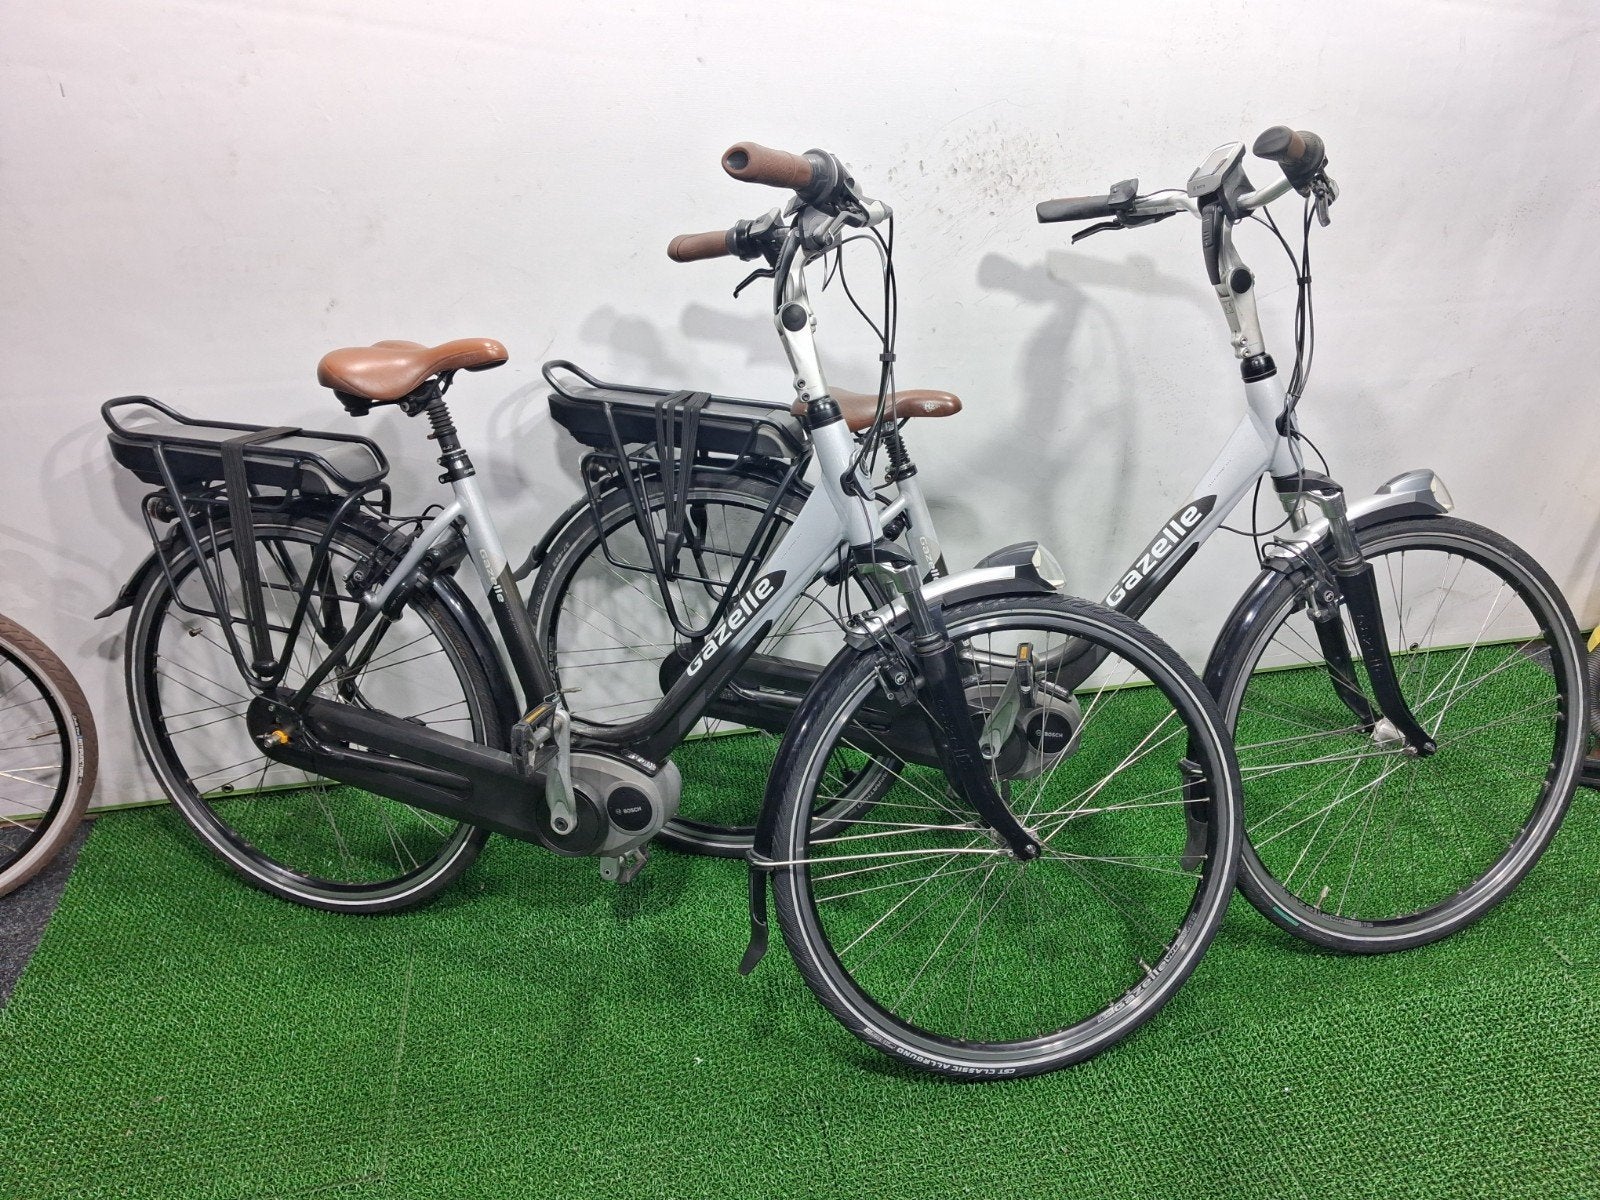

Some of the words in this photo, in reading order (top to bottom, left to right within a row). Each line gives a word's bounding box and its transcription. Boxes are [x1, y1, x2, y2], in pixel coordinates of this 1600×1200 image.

[1106, 505, 1203, 607] Gazelle
[479, 549, 505, 603] Gazelle
[686, 577, 775, 677] Gazelle
[623, 806, 642, 814] BOSCH
[896, 1047, 951, 1070] ALLROUND
[951, 1064, 995, 1075] CLASSIC
